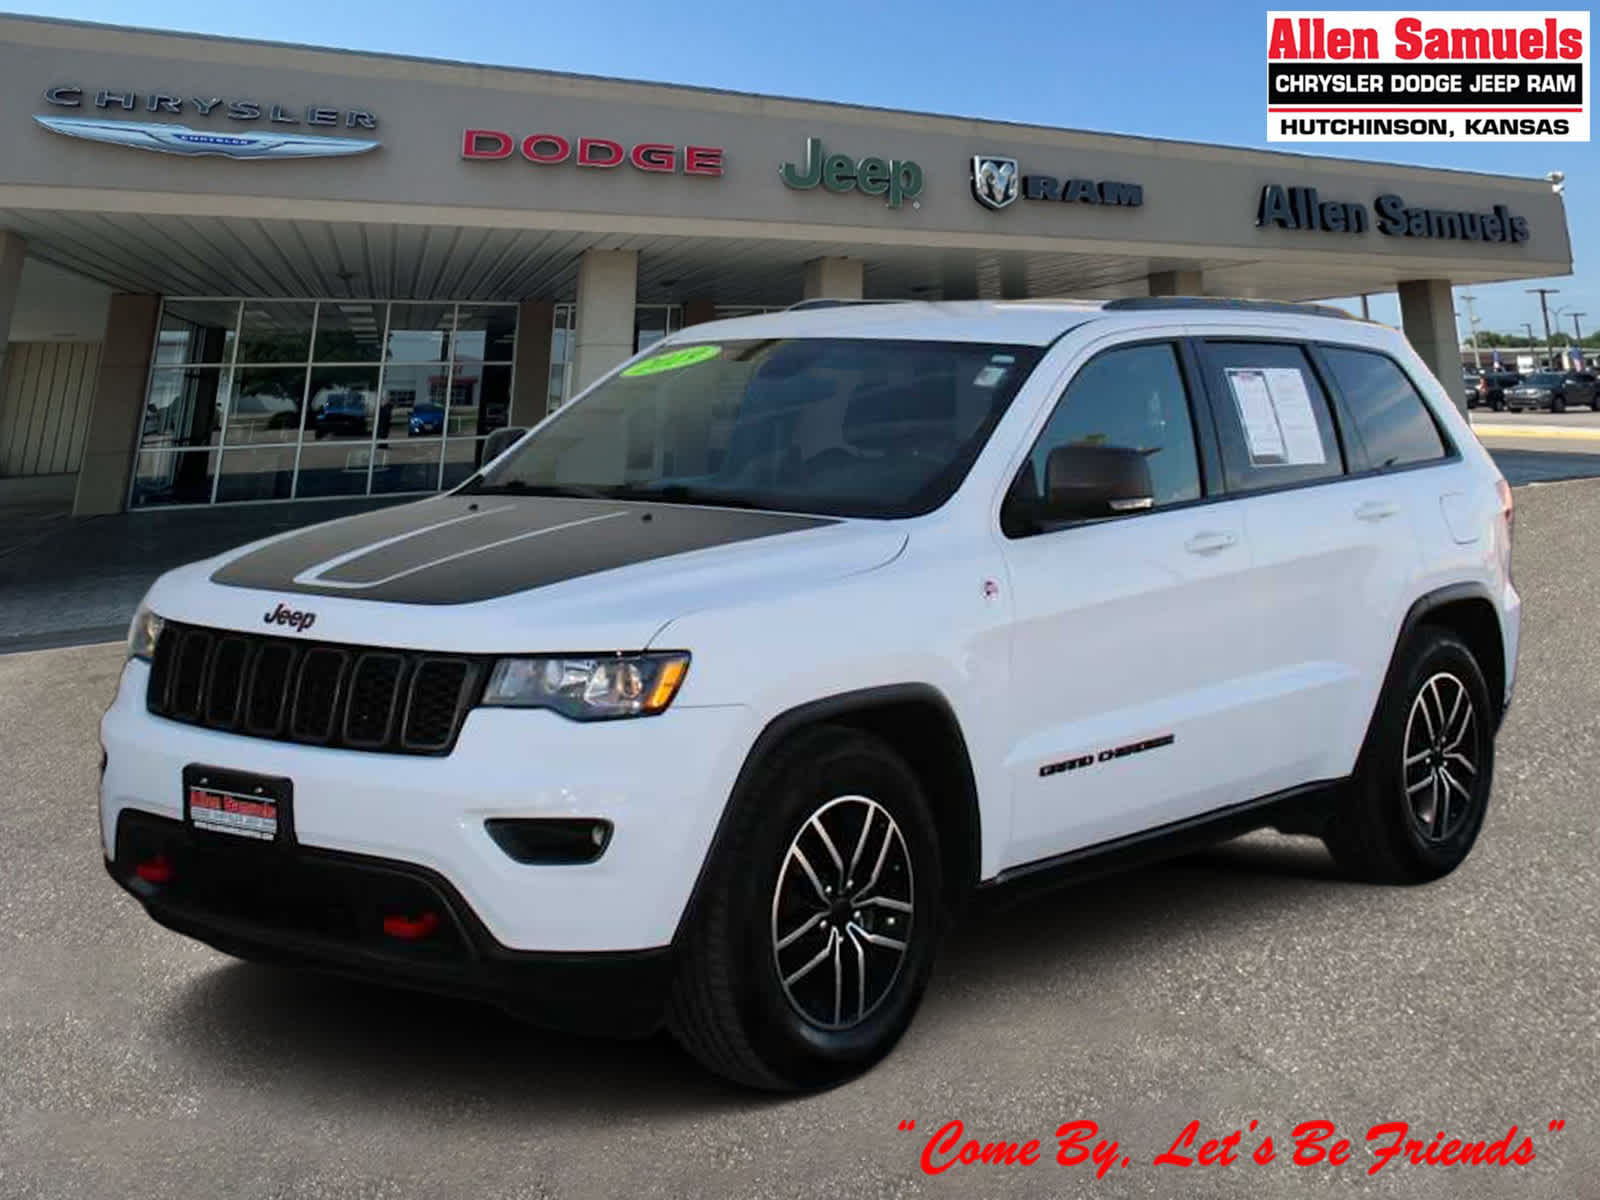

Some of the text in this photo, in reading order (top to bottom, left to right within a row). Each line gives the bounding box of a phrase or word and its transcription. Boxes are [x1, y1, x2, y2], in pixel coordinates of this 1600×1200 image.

[44, 86, 378, 129] CHRYSLER
[461, 129, 724, 176] DODGE
[778, 137, 924, 208] Jeep
[1023, 176, 1143, 207] RAM
[1256, 184, 1530, 243] Allen Samuels
[263, 603, 316, 632] Jeep
